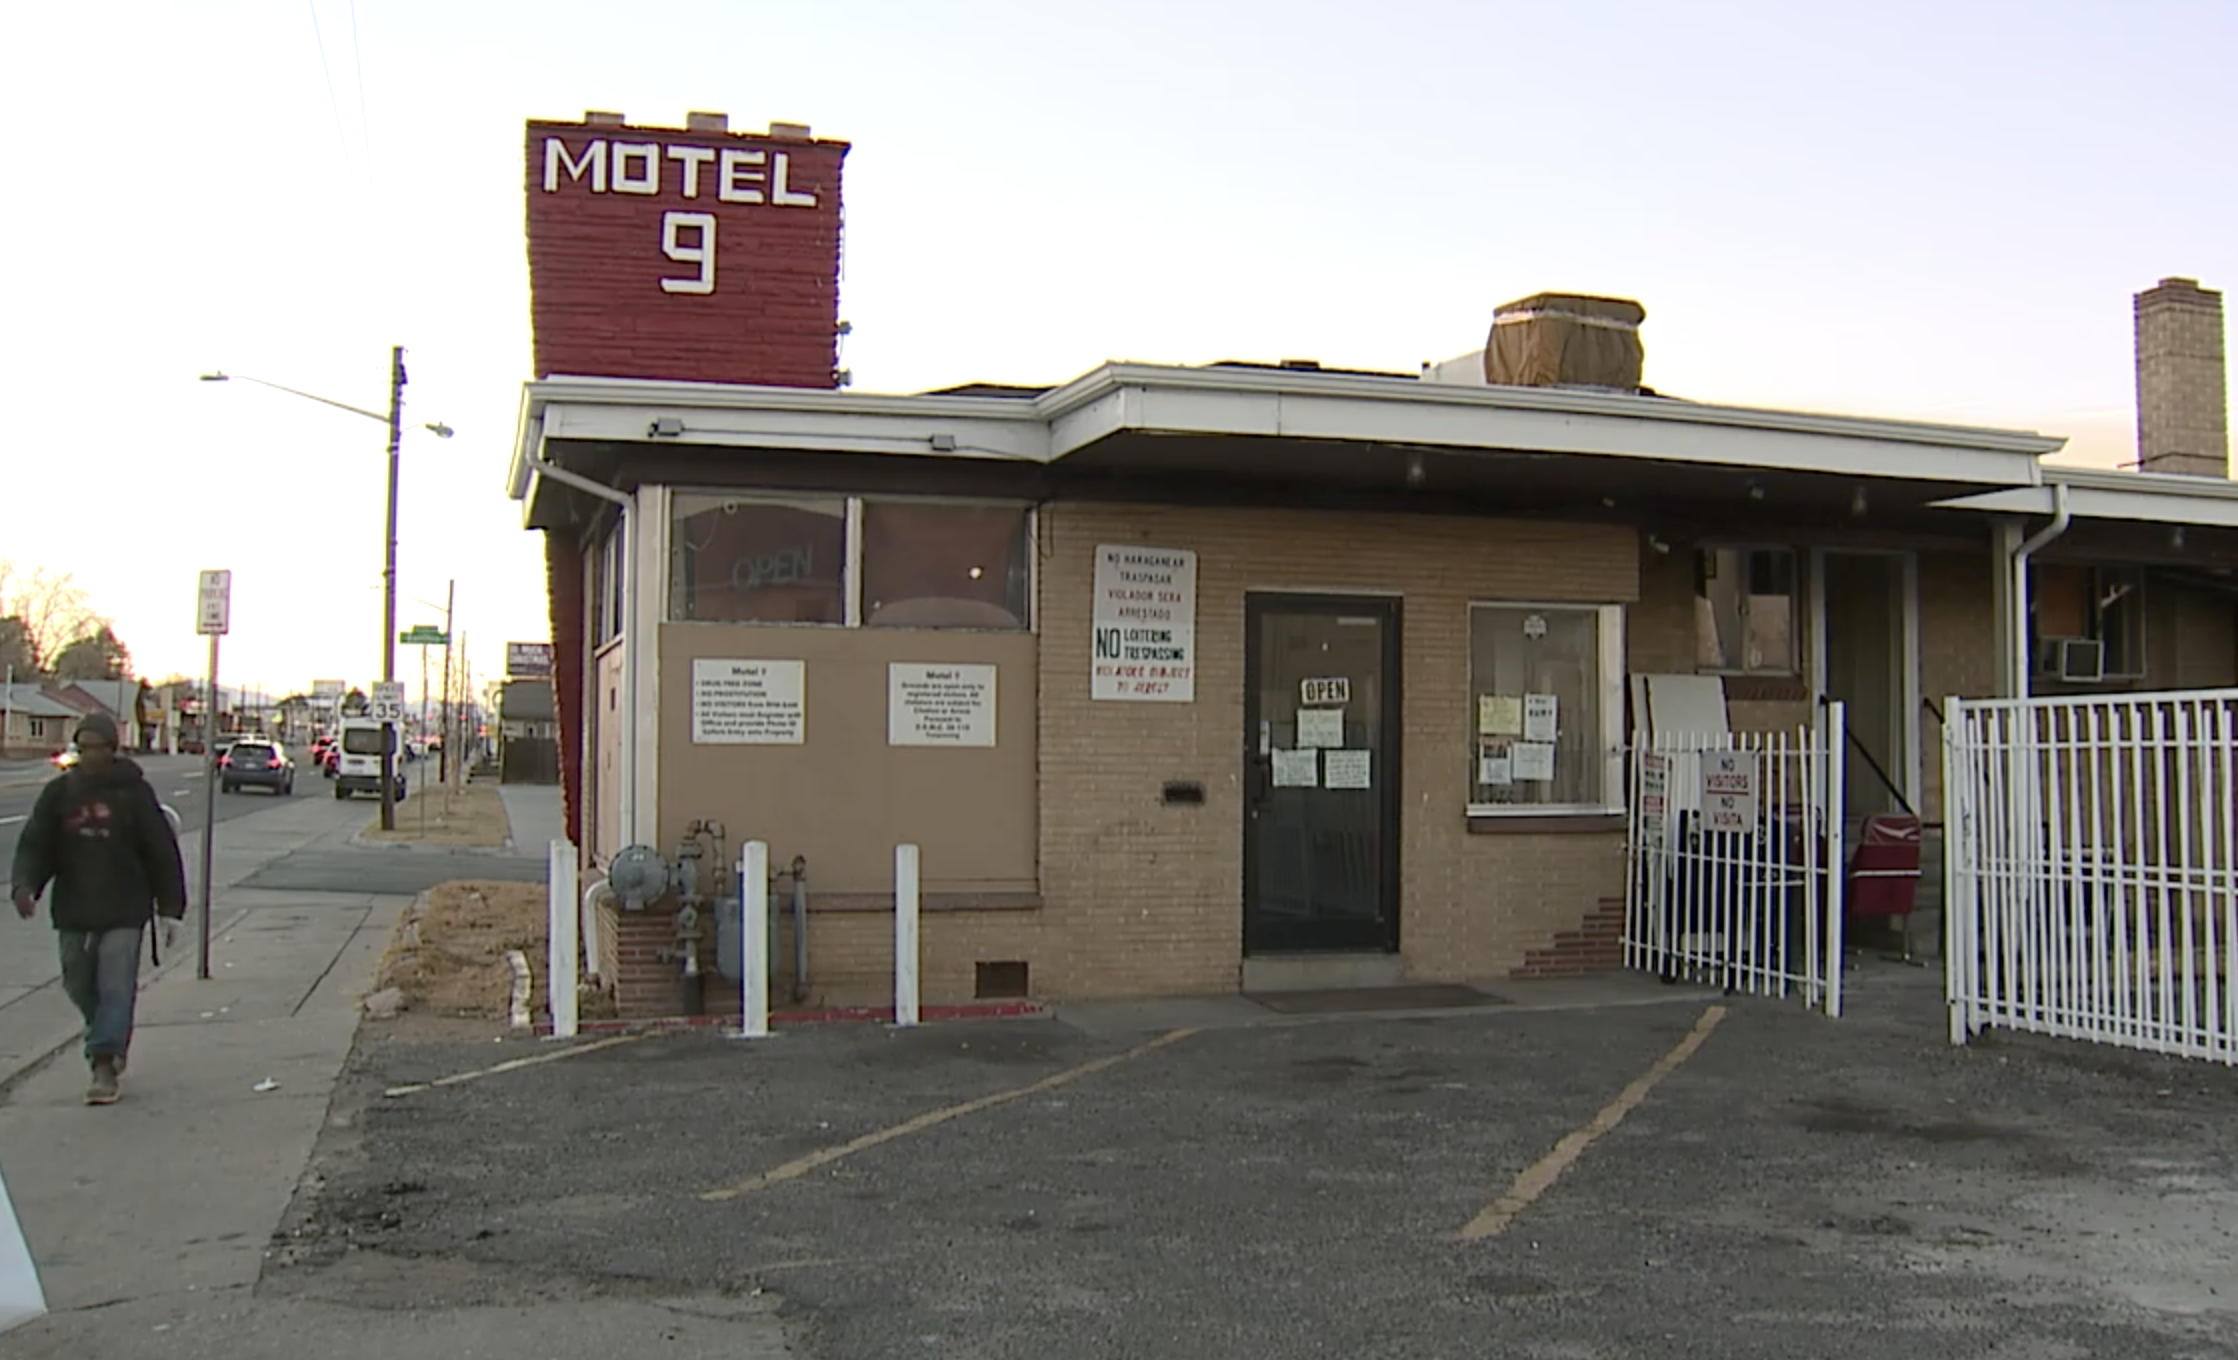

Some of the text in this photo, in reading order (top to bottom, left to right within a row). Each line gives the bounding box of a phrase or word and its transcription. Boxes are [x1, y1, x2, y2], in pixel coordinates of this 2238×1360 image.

[543, 137, 817, 207] MOTEL
[660, 210, 717, 294] 9
[1107, 553, 1120, 565] NO
[732, 544, 813, 590] OPEN
[1120, 571, 1172, 584] TRASPASAR
[1108, 588, 1181, 602] VIOLADOR SERA
[1118, 607, 1171, 621] ARRESTADO
[1124, 628, 1172, 643] LOITERING
[1096, 628, 1121, 658] NO
[1124, 646, 1185, 661] TRESPASSING
[732, 667, 758, 675] Motel
[926, 671, 952, 679] Motel
[1306, 681, 1346, 700] OPEN
[376, 703, 400, 719] 35
[1722, 758, 1735, 772] NO
[1706, 774, 1748, 789] VISITORS
[1722, 796, 1734, 809] NO
[1714, 811, 1743, 825] VISITA
